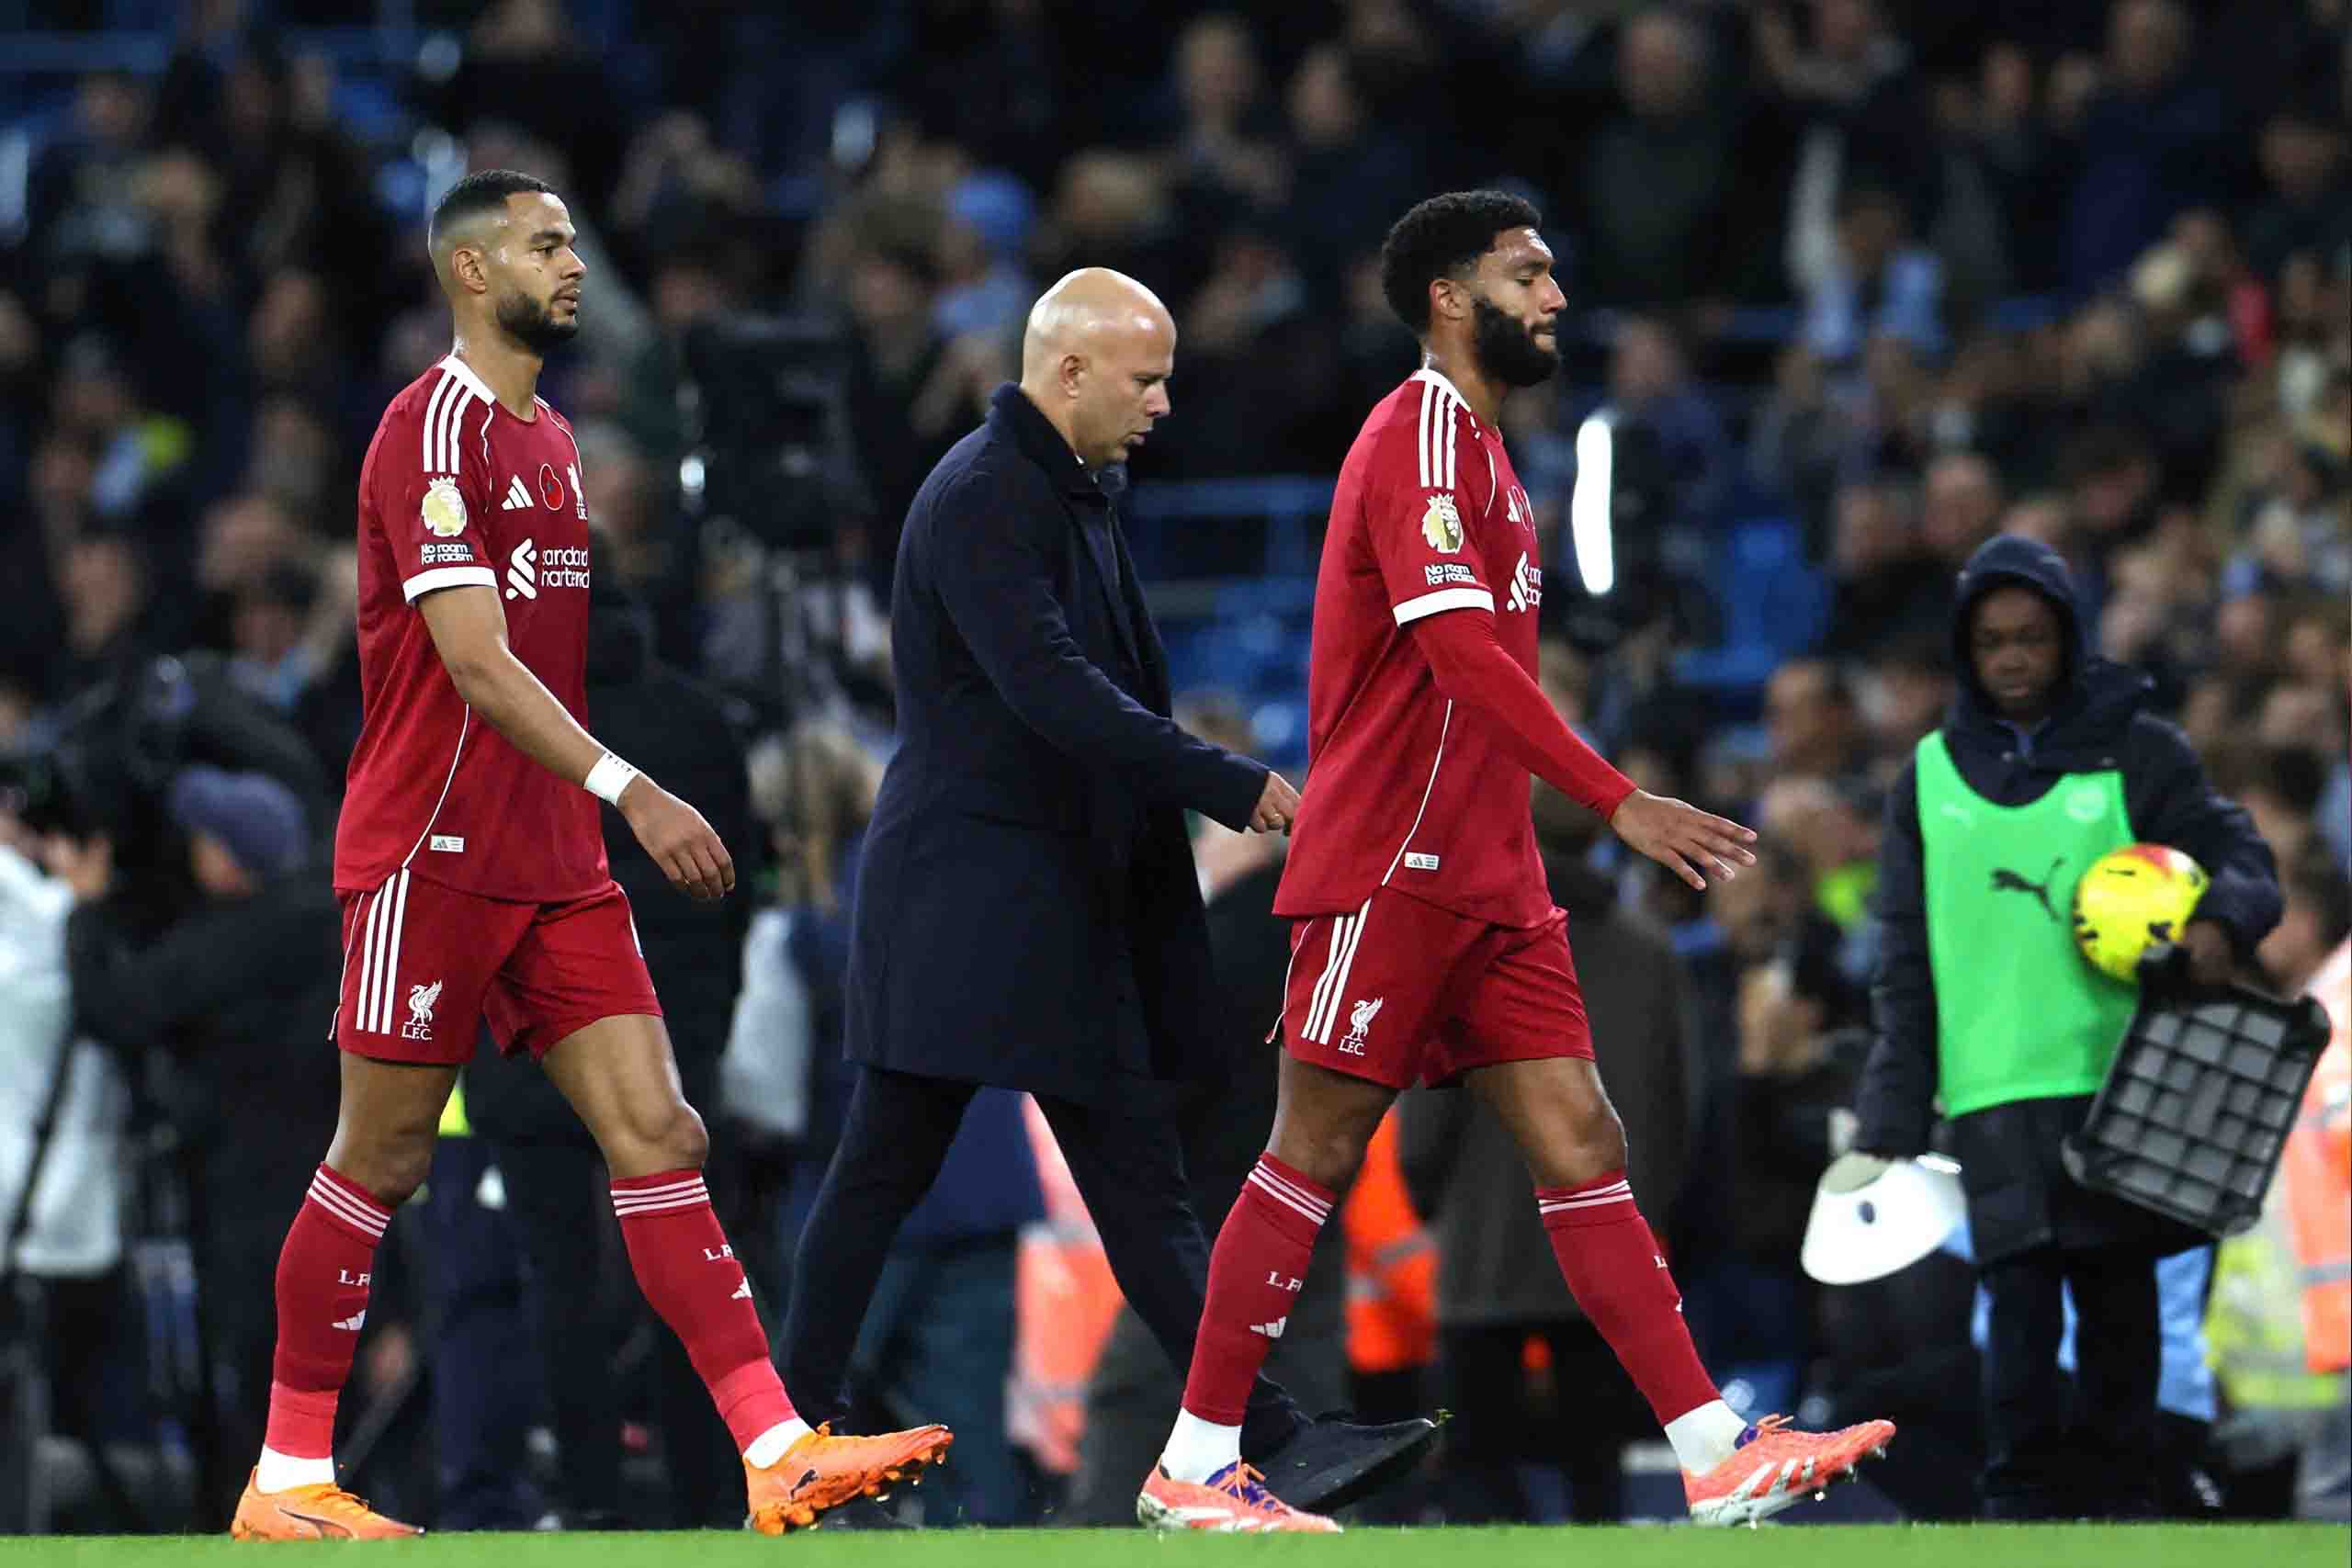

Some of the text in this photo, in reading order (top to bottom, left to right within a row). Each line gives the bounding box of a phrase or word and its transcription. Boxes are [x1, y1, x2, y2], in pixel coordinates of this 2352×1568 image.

[436, 543, 469, 553] room
[421, 553, 474, 566] for racism
[1424, 563, 1471, 576] No room
[1426, 574, 1445, 586] for
